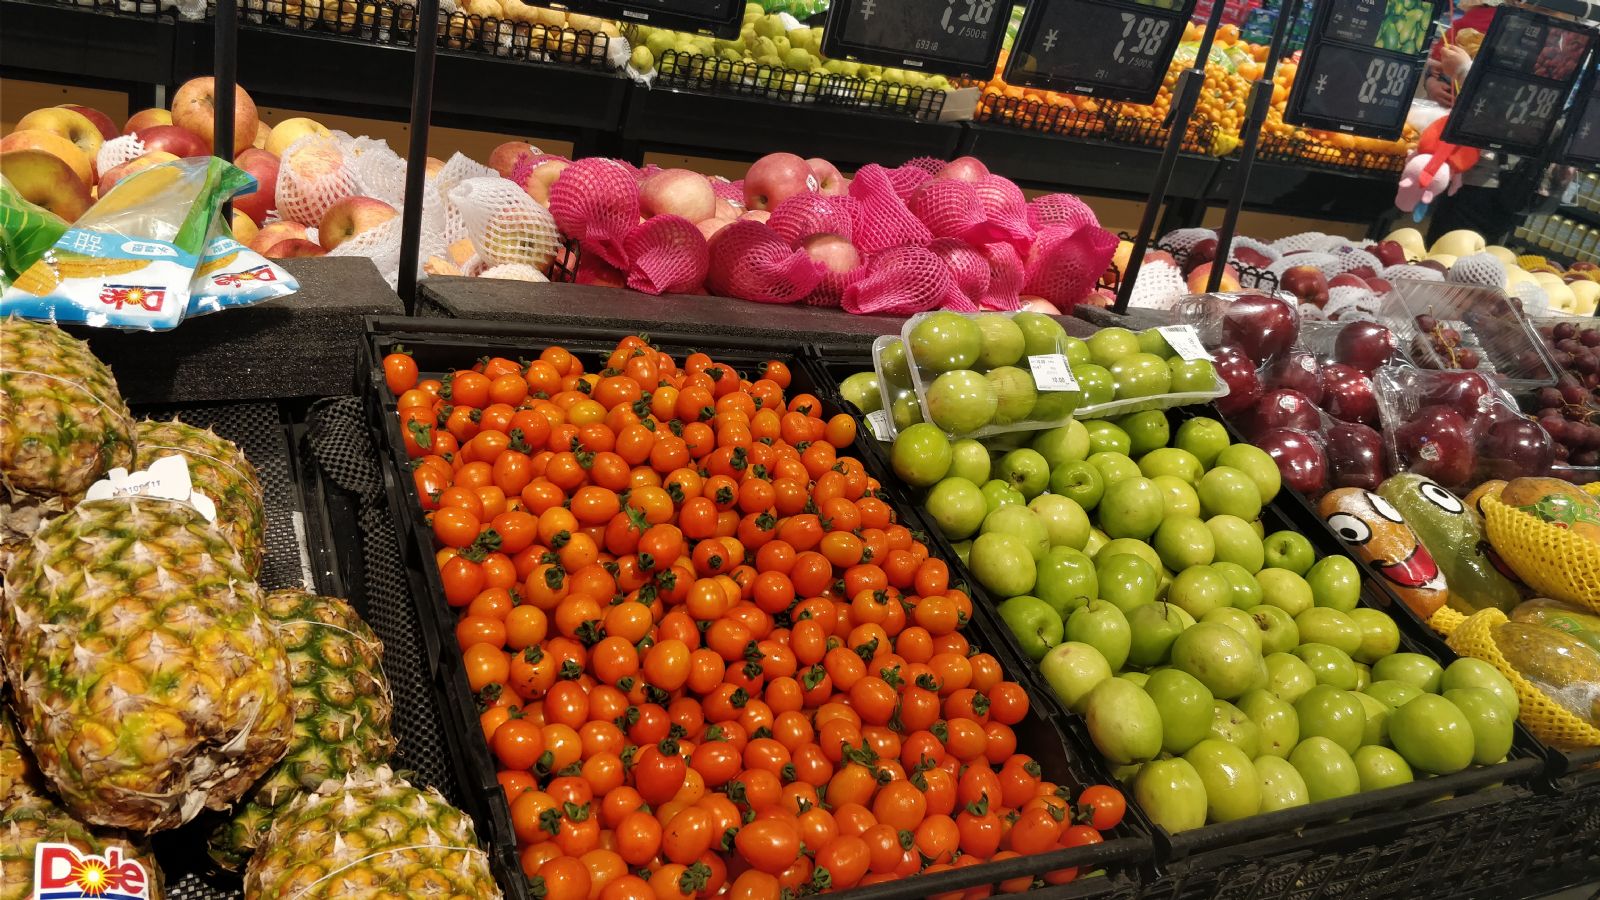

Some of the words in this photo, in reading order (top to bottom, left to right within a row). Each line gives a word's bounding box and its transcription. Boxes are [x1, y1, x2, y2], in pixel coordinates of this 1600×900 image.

[1042, 28, 1059, 53] ¥
[1113, 12, 1171, 64] 7.98
[1314, 73, 1329, 96] ¥
[1357, 58, 1411, 105] 8.98
[1505, 84, 1560, 125] 13.98
[98, 286, 166, 312] Dole
[40, 847, 145, 895] Dole
